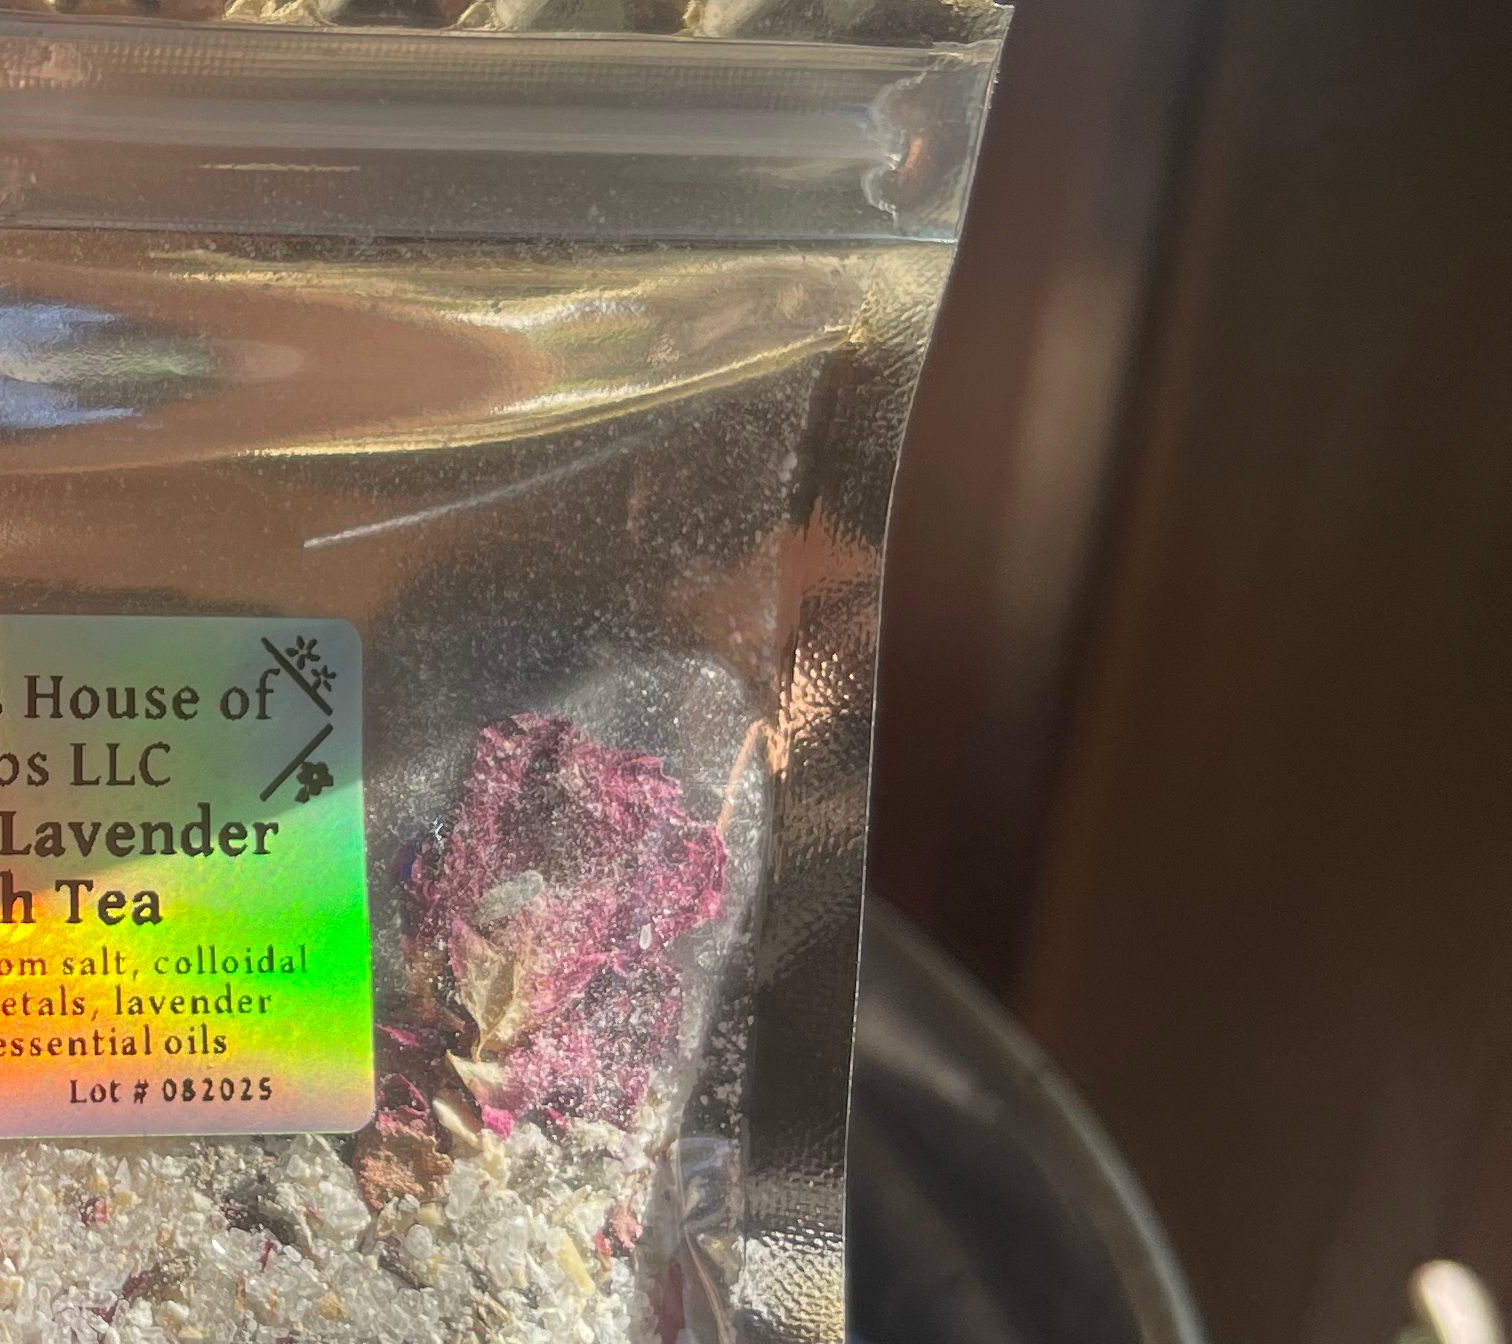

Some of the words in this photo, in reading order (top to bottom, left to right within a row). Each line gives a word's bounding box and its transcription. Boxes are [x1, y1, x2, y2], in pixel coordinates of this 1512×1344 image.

[23, 674, 201, 721] House
[218, 666, 281, 722] of
[70, 741, 172, 788] LLC
[54, 879, 164, 927] Tea
[61, 947, 139, 981] salt,
[153, 943, 310, 977] colloidal
[114, 983, 273, 1017] lavender
[163, 1023, 229, 1056] oils
[68, 1078, 124, 1106] Lot
[132, 1078, 150, 1105] #
[161, 1075, 274, 1104] 082025
